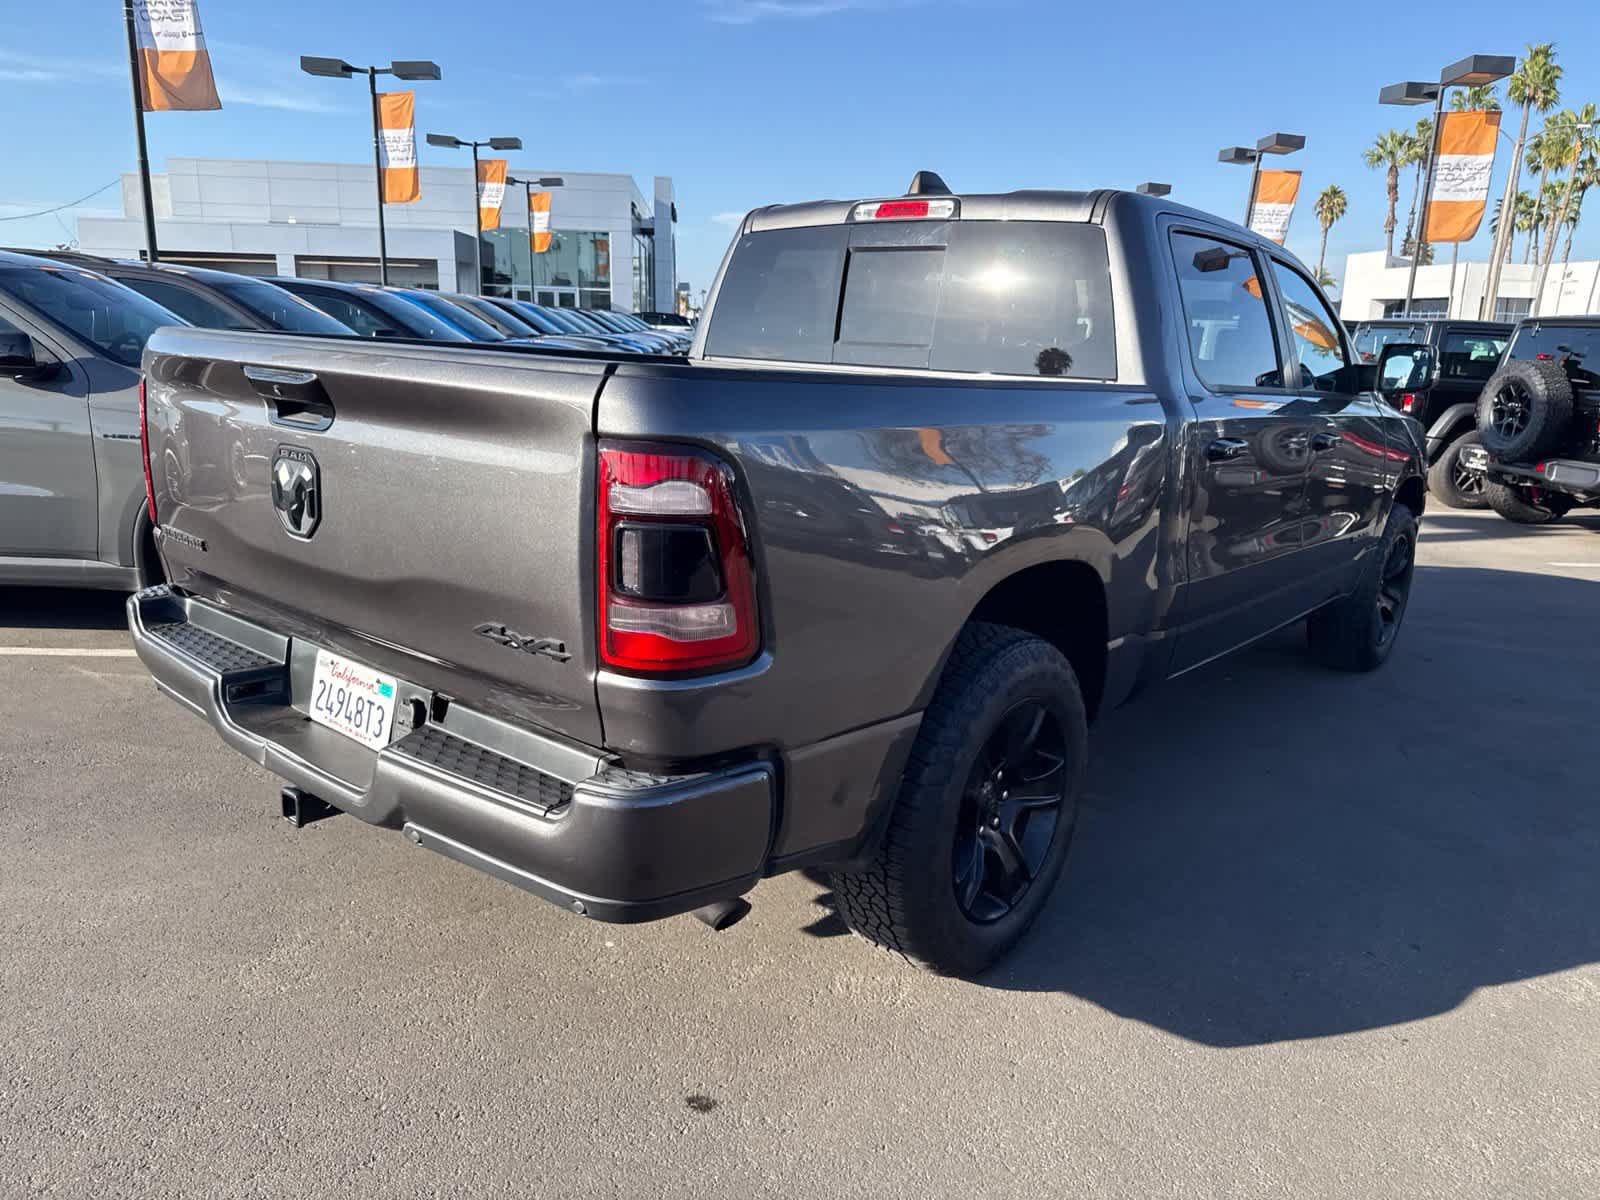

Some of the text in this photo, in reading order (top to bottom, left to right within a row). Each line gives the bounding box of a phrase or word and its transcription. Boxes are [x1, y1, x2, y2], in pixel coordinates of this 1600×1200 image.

[280, 448, 308, 461] RAM
[331, 662, 378, 695] California
[315, 679, 385, 738] 24948T3
